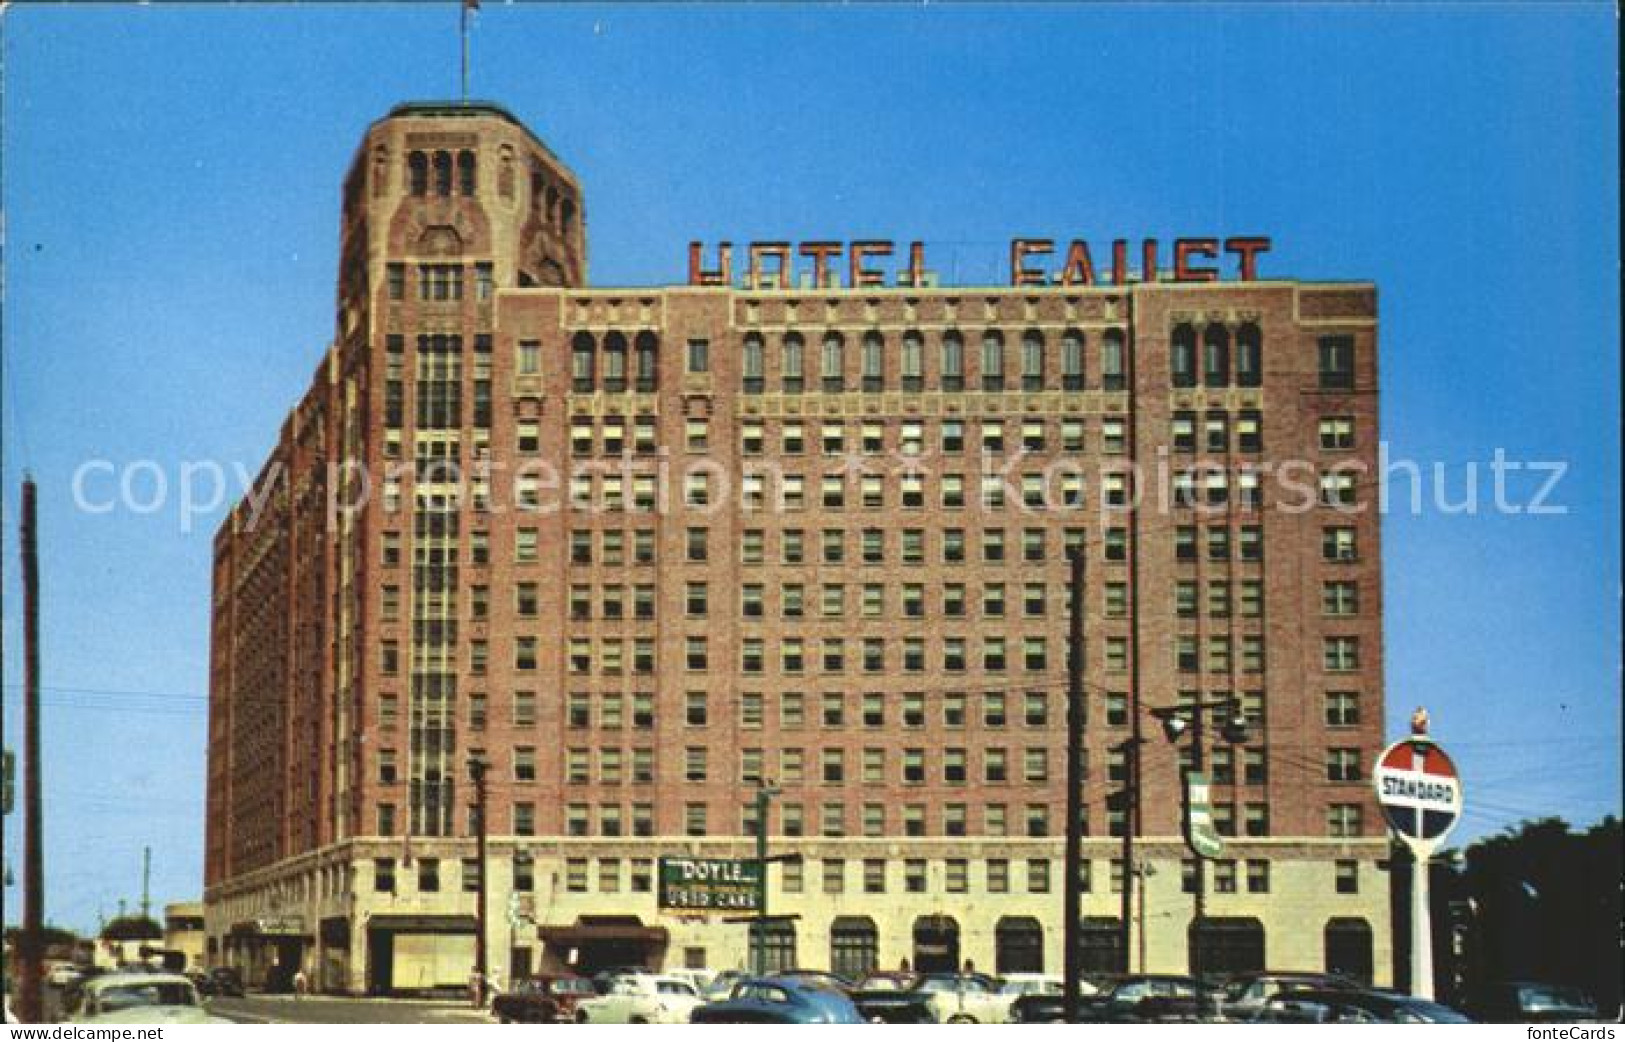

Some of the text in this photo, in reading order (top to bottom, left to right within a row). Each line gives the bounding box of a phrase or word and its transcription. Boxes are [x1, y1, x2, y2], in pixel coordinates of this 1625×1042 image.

[689, 237, 1272, 289] HOTEL FAUST
[1383, 776, 1453, 803] STANDARD
